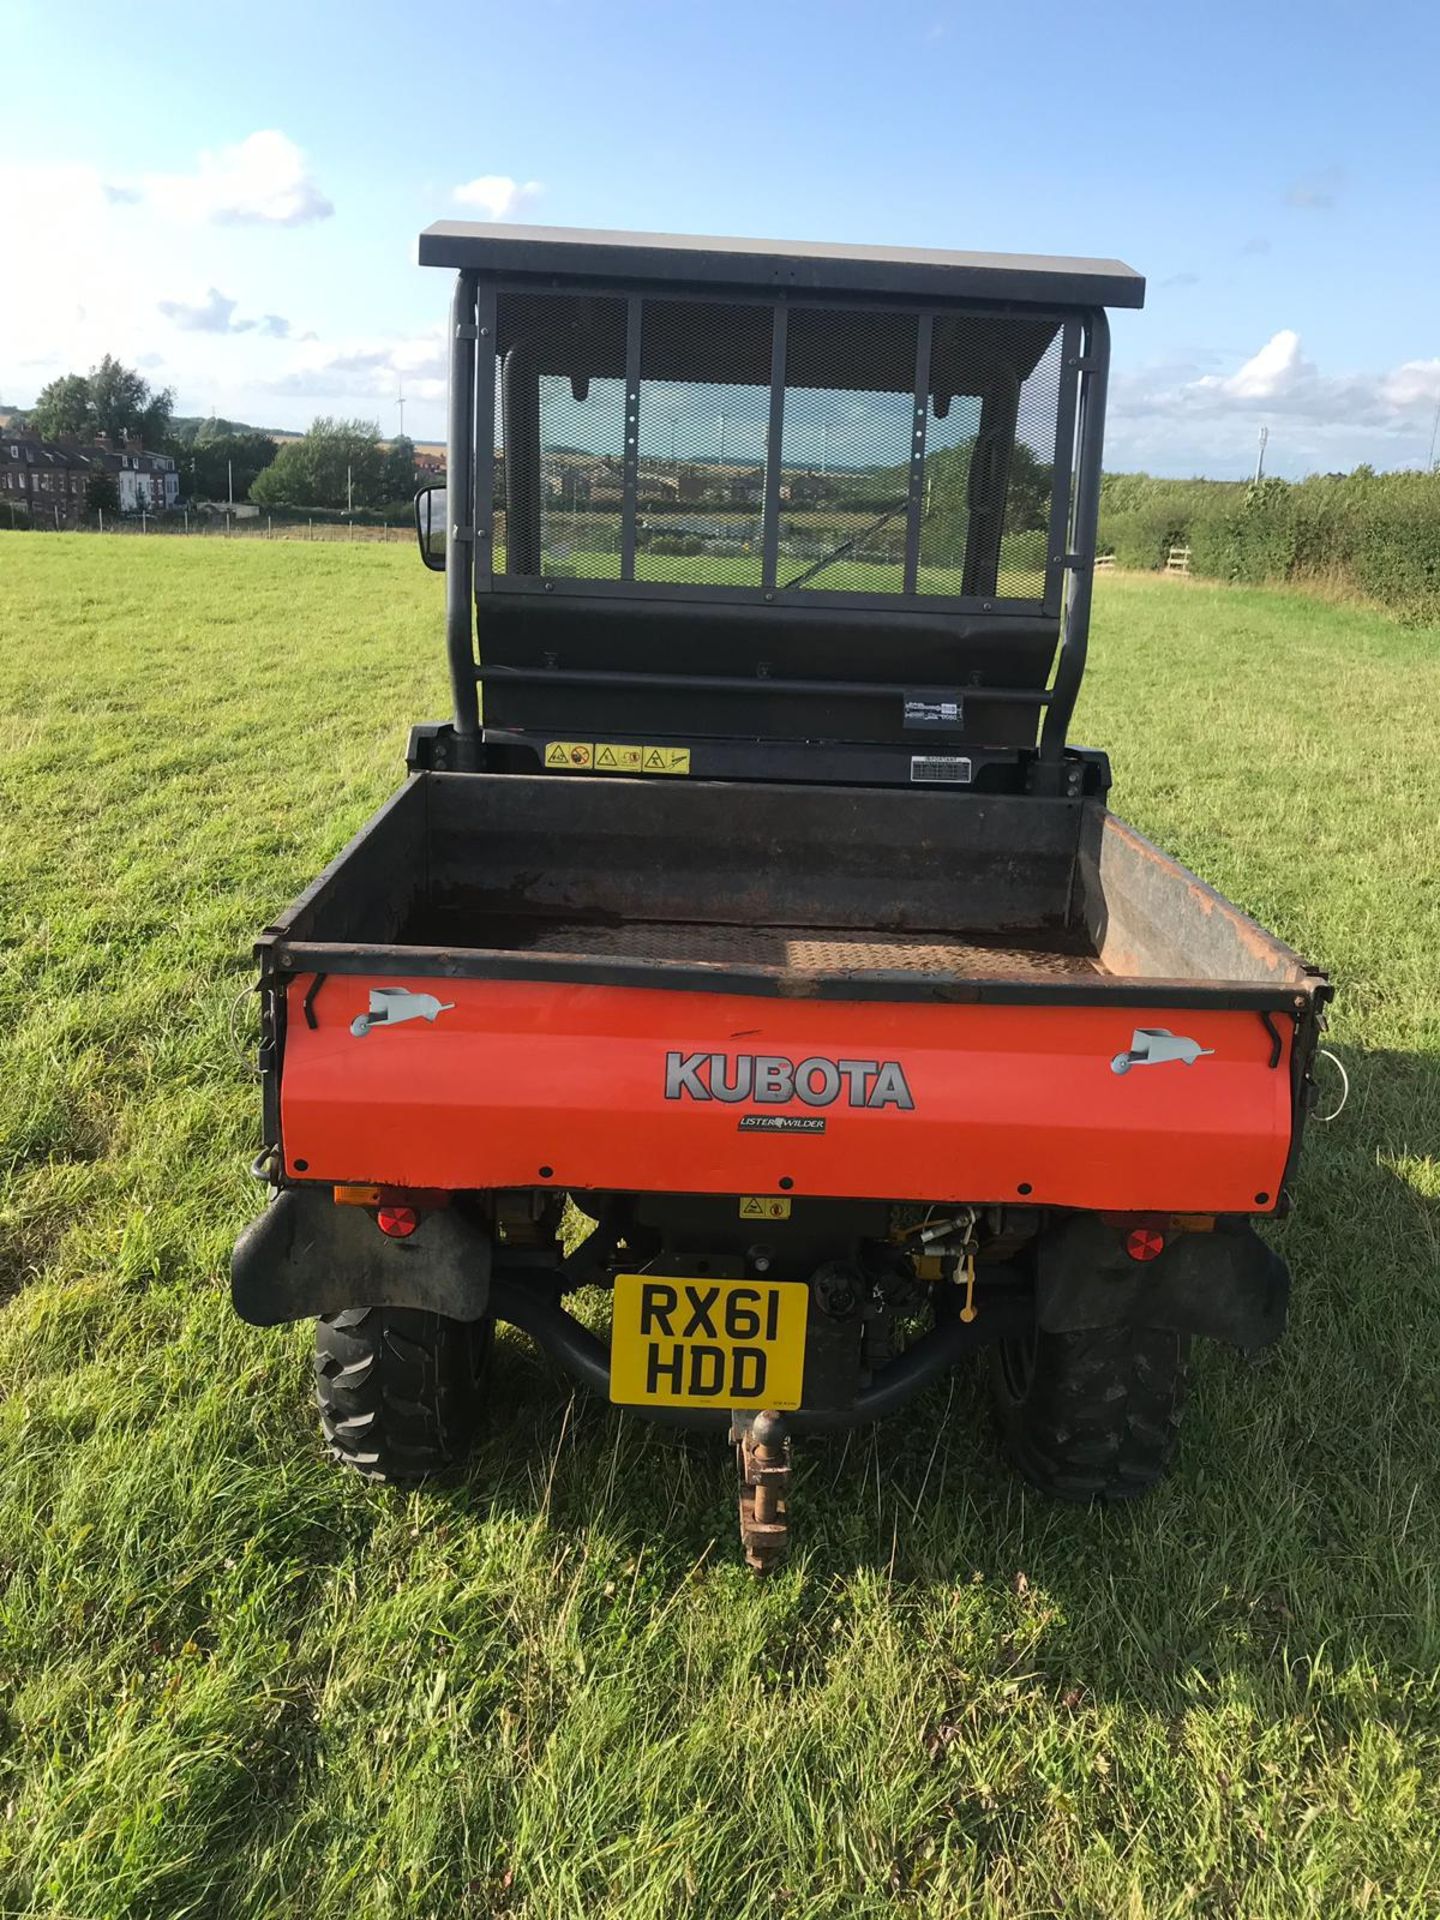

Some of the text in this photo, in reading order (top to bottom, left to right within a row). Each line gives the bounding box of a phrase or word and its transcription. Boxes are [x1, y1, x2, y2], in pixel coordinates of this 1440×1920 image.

[664, 1052, 915, 1109] KUBOTA
[740, 1117, 824, 1128] LISTER WILDER
[640, 1283, 780, 1341] RX61
[646, 1343, 767, 1398] HDD
